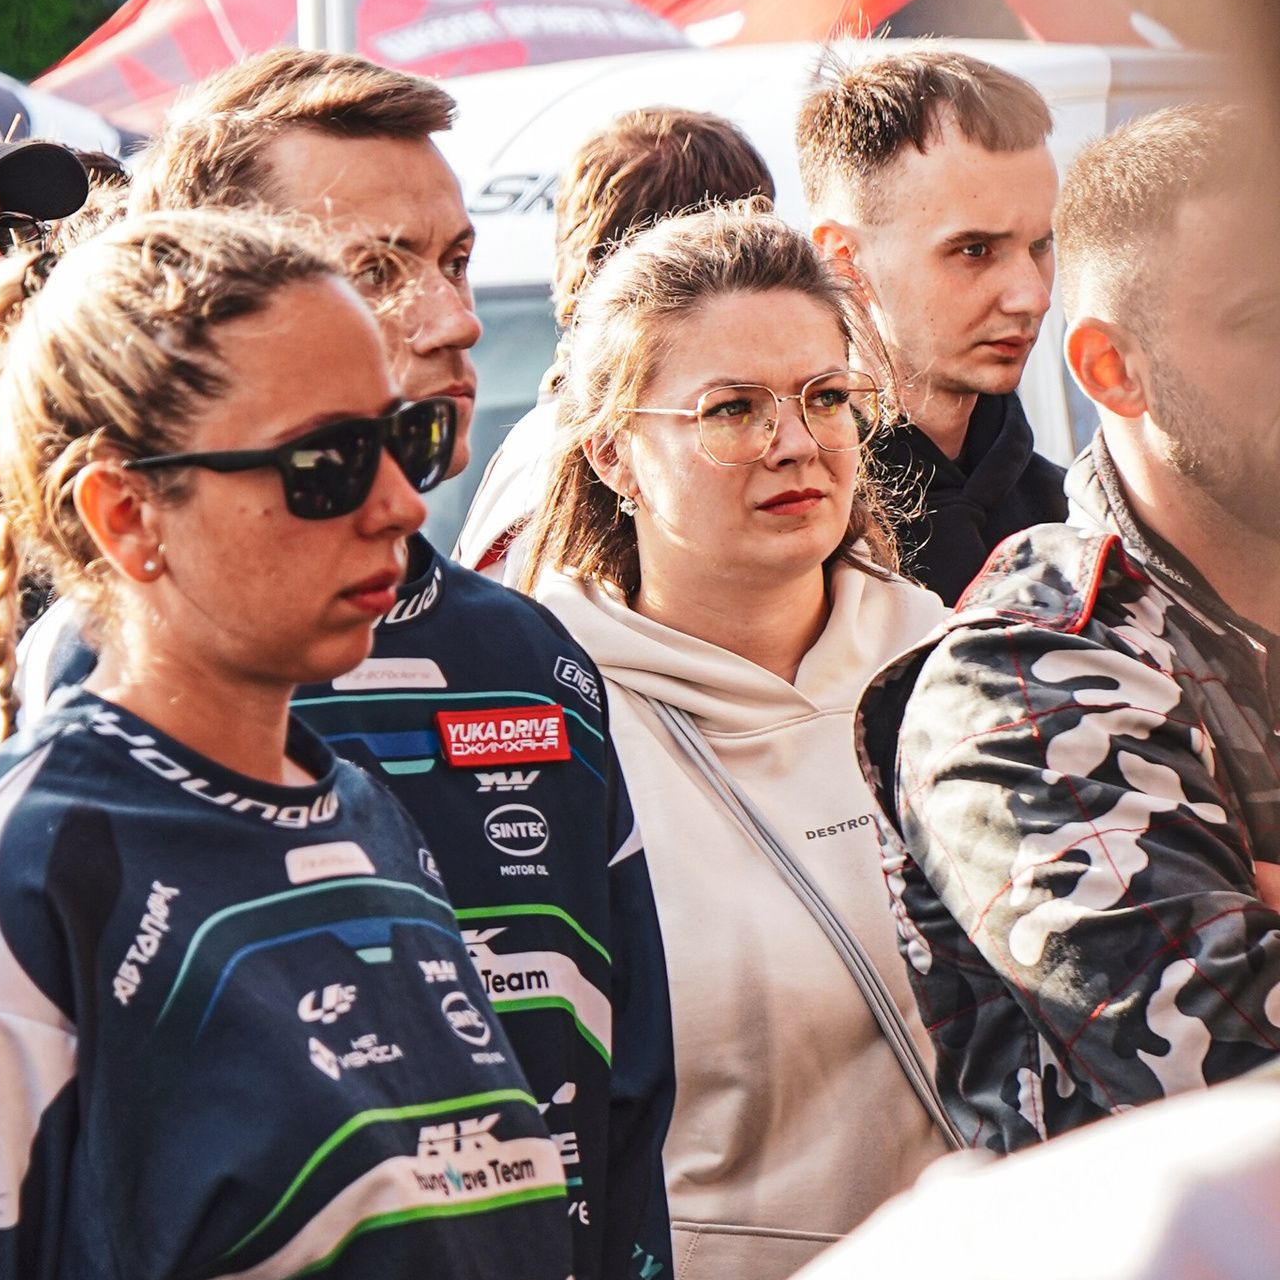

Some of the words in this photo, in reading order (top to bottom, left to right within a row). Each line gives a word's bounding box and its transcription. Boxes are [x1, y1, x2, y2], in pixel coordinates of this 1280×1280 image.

[446, 722, 498, 742] YUKA
[500, 717, 560, 741] DRIVE
[489, 822, 546, 839] SINTEC
[500, 864, 536, 876] MOTOR
[481, 969, 550, 995] Team
[487, 1157, 536, 1186] Team
